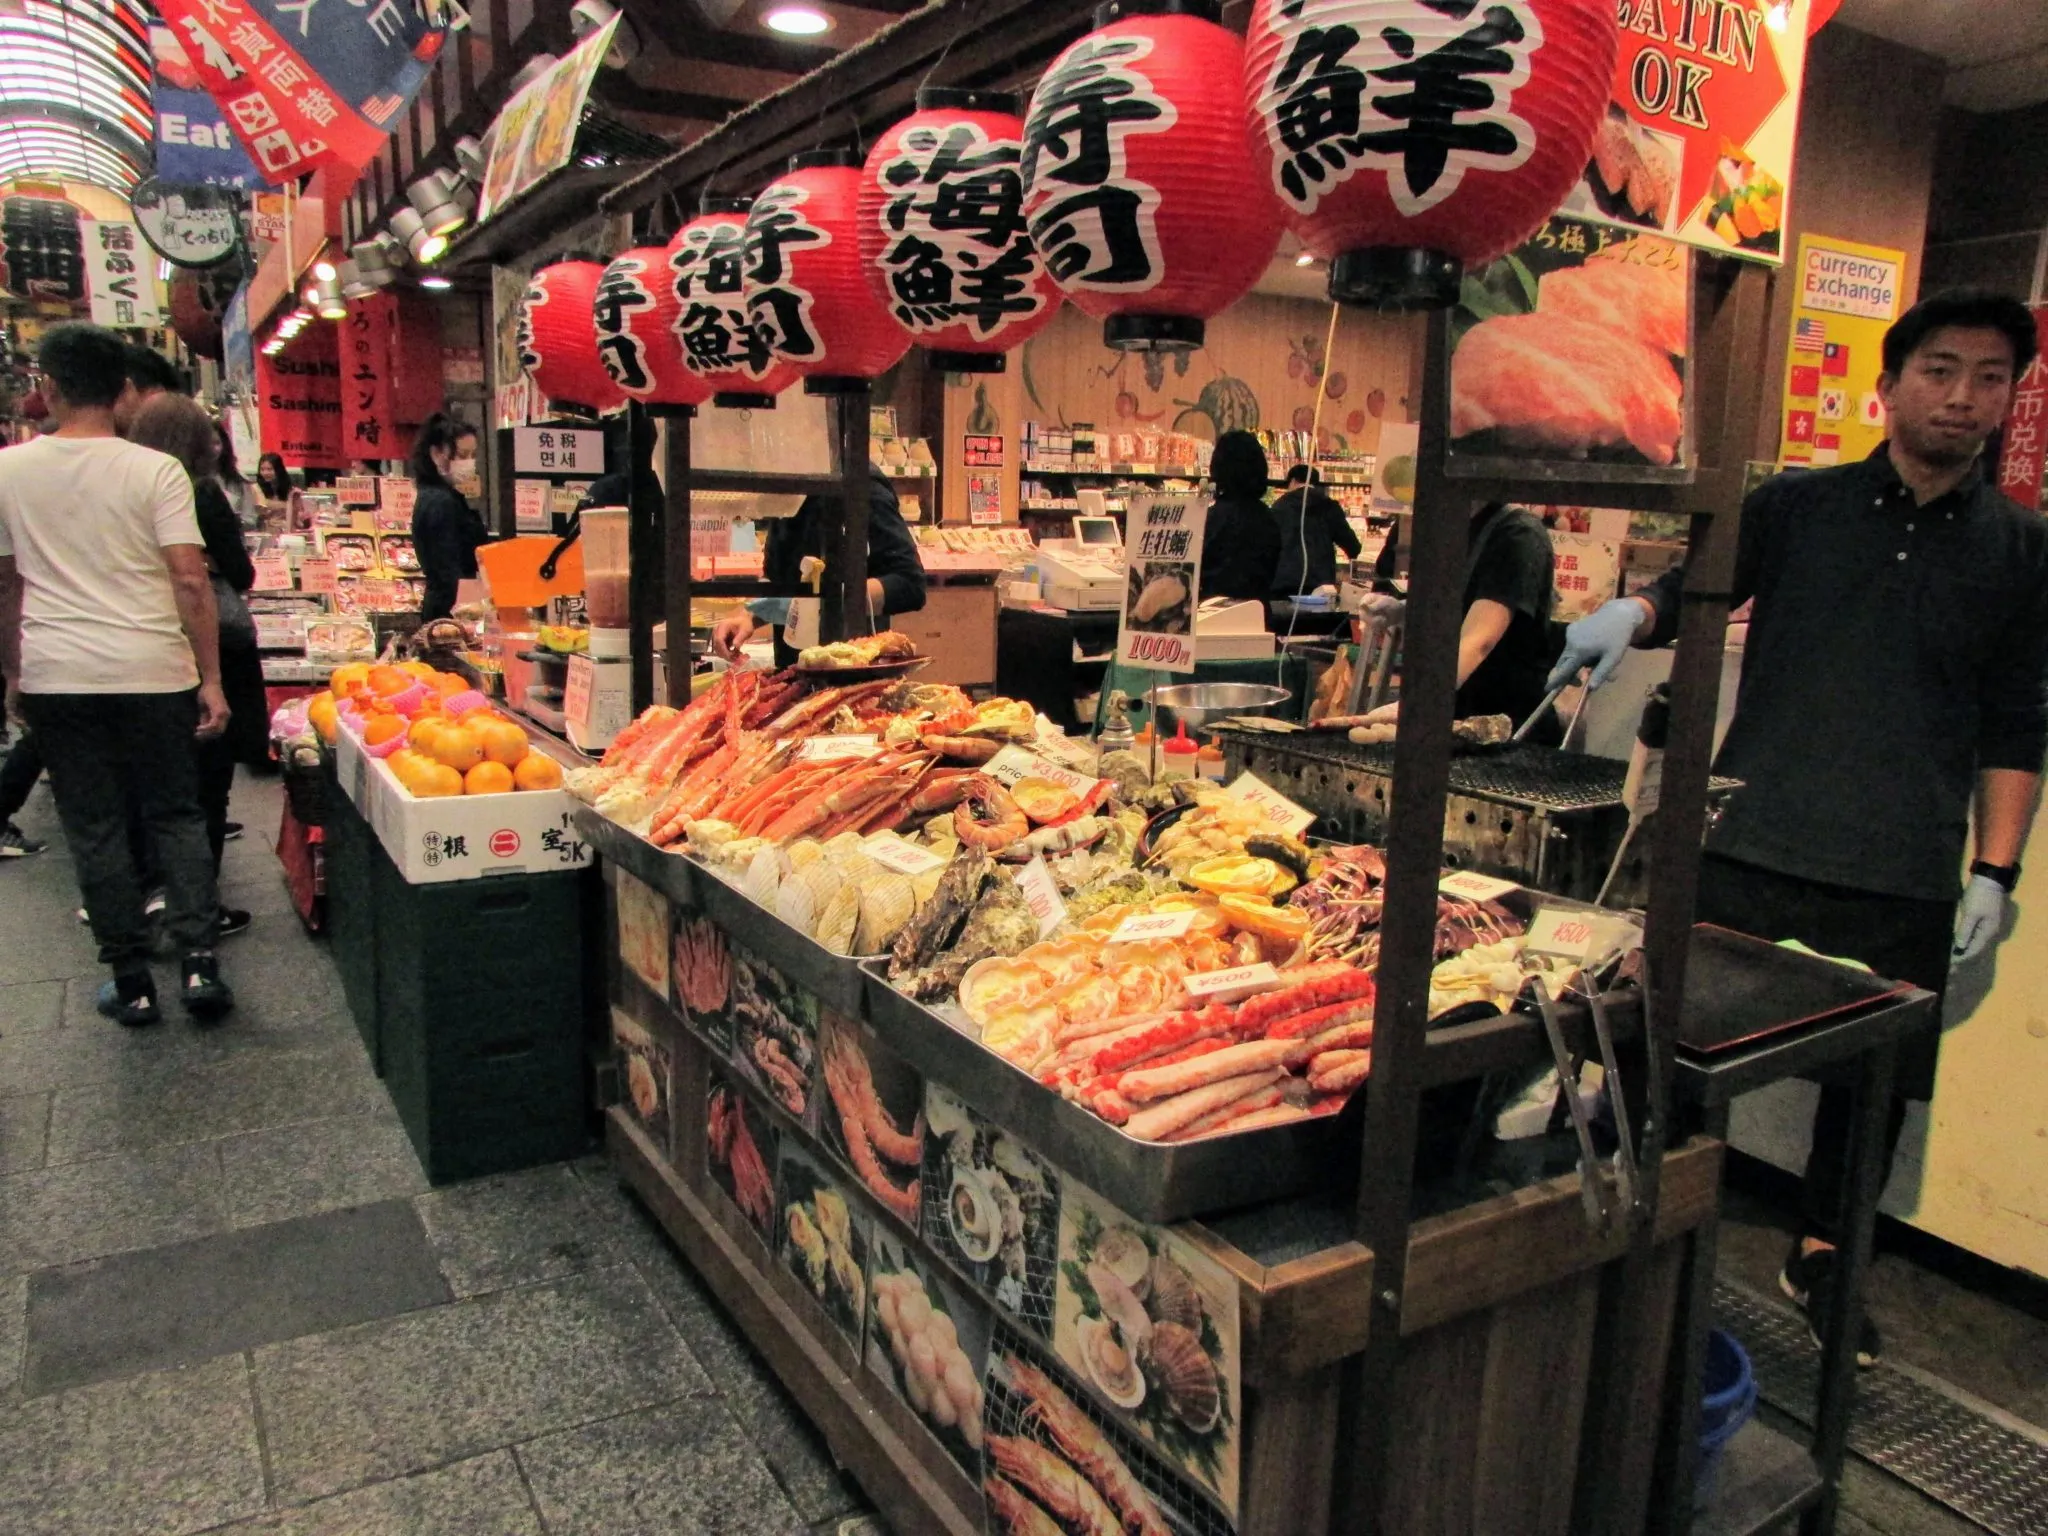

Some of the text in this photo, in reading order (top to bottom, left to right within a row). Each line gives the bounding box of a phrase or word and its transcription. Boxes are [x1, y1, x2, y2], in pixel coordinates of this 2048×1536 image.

[1276, 0, 1524, 201] 鮮
[1631, 47, 1712, 130] OK
[160, 114, 231, 149] Eat
[1021, 40, 1163, 284] 寿司
[884, 126, 1038, 333] 海鮮
[745, 188, 821, 355] 寿司
[1808, 252, 1888, 284] Currency
[1805, 273, 1892, 304] Exchange
[269, 395, 342, 413] Sashim
[540, 451, 577, 468] 면세
[443, 835, 469, 858] 根
[1196, 971, 1253, 987] ¥500
